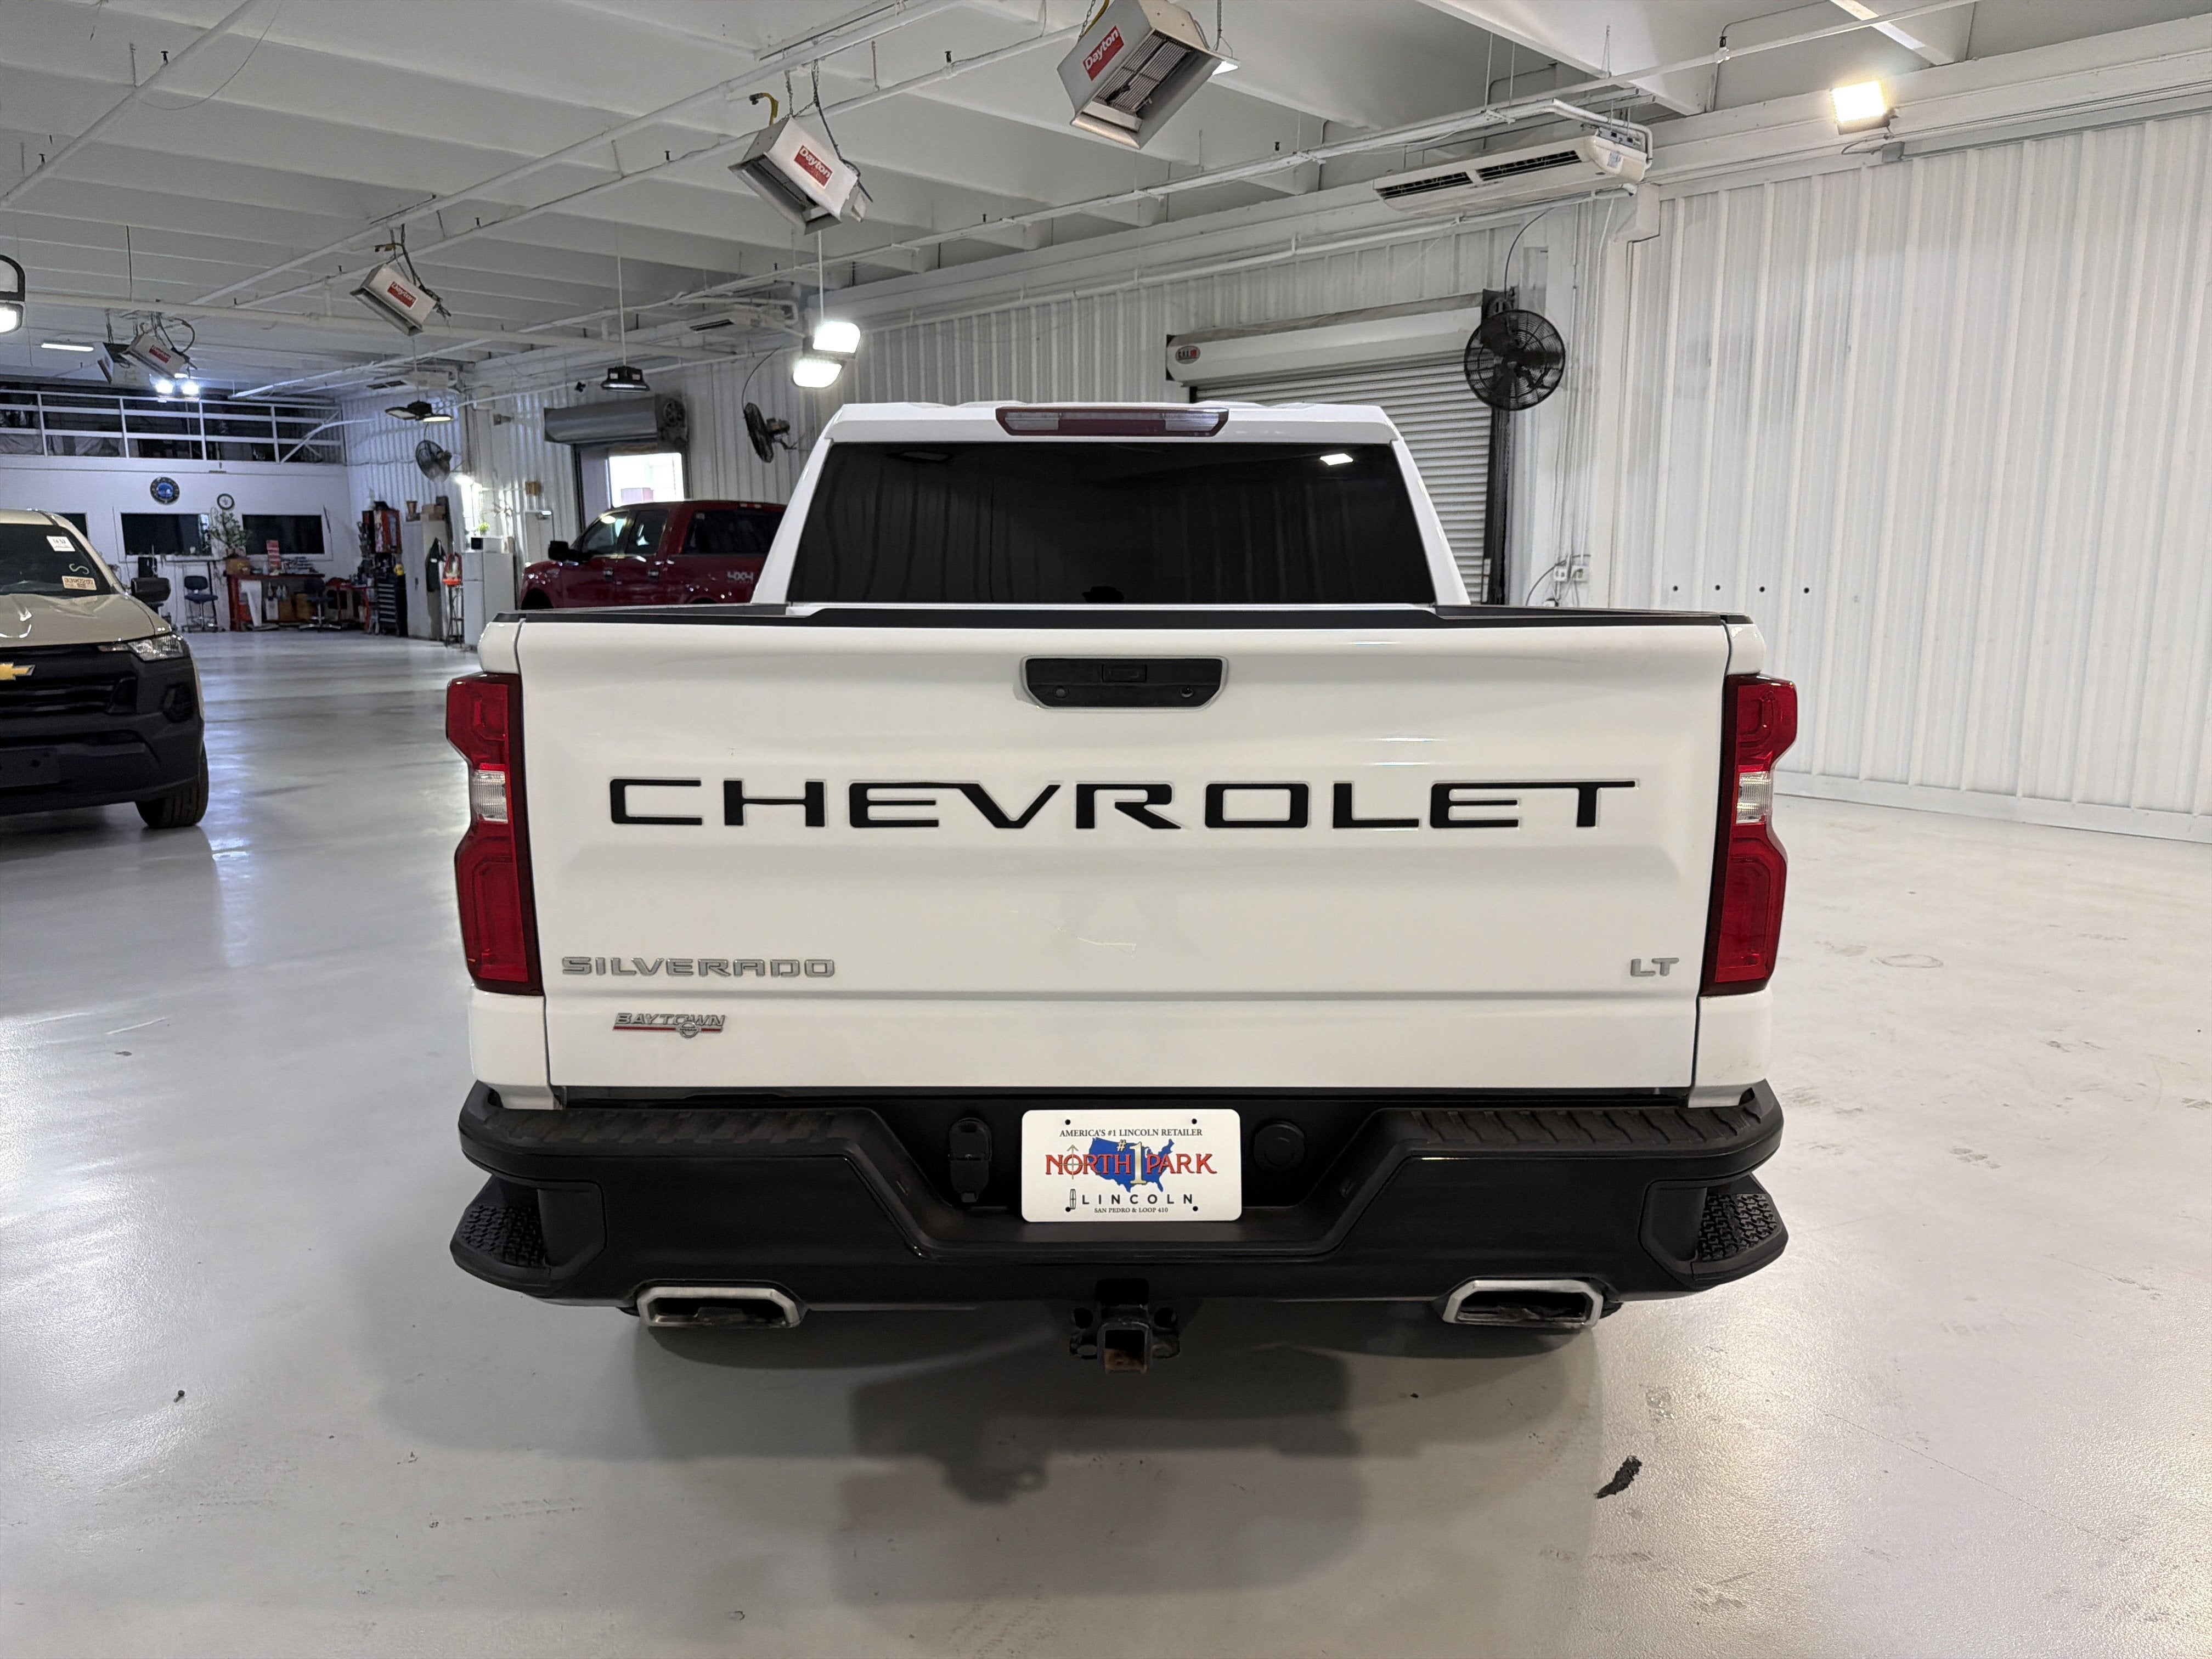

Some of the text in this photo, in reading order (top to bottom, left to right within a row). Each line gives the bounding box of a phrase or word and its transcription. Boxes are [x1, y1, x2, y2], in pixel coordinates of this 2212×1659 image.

[1085, 30, 1119, 70] Dayton
[800, 148, 831, 178] Dayton
[610, 778, 1635, 828] CHEVROLET
[561, 956, 835, 977] SILVERADO
[1630, 957, 1680, 977] LT
[615, 1012, 725, 1027] BAYTOWN
[1045, 1153, 1218, 1175] NORTH PARK
[1082, 1194, 1193, 1204] LINCOLN
